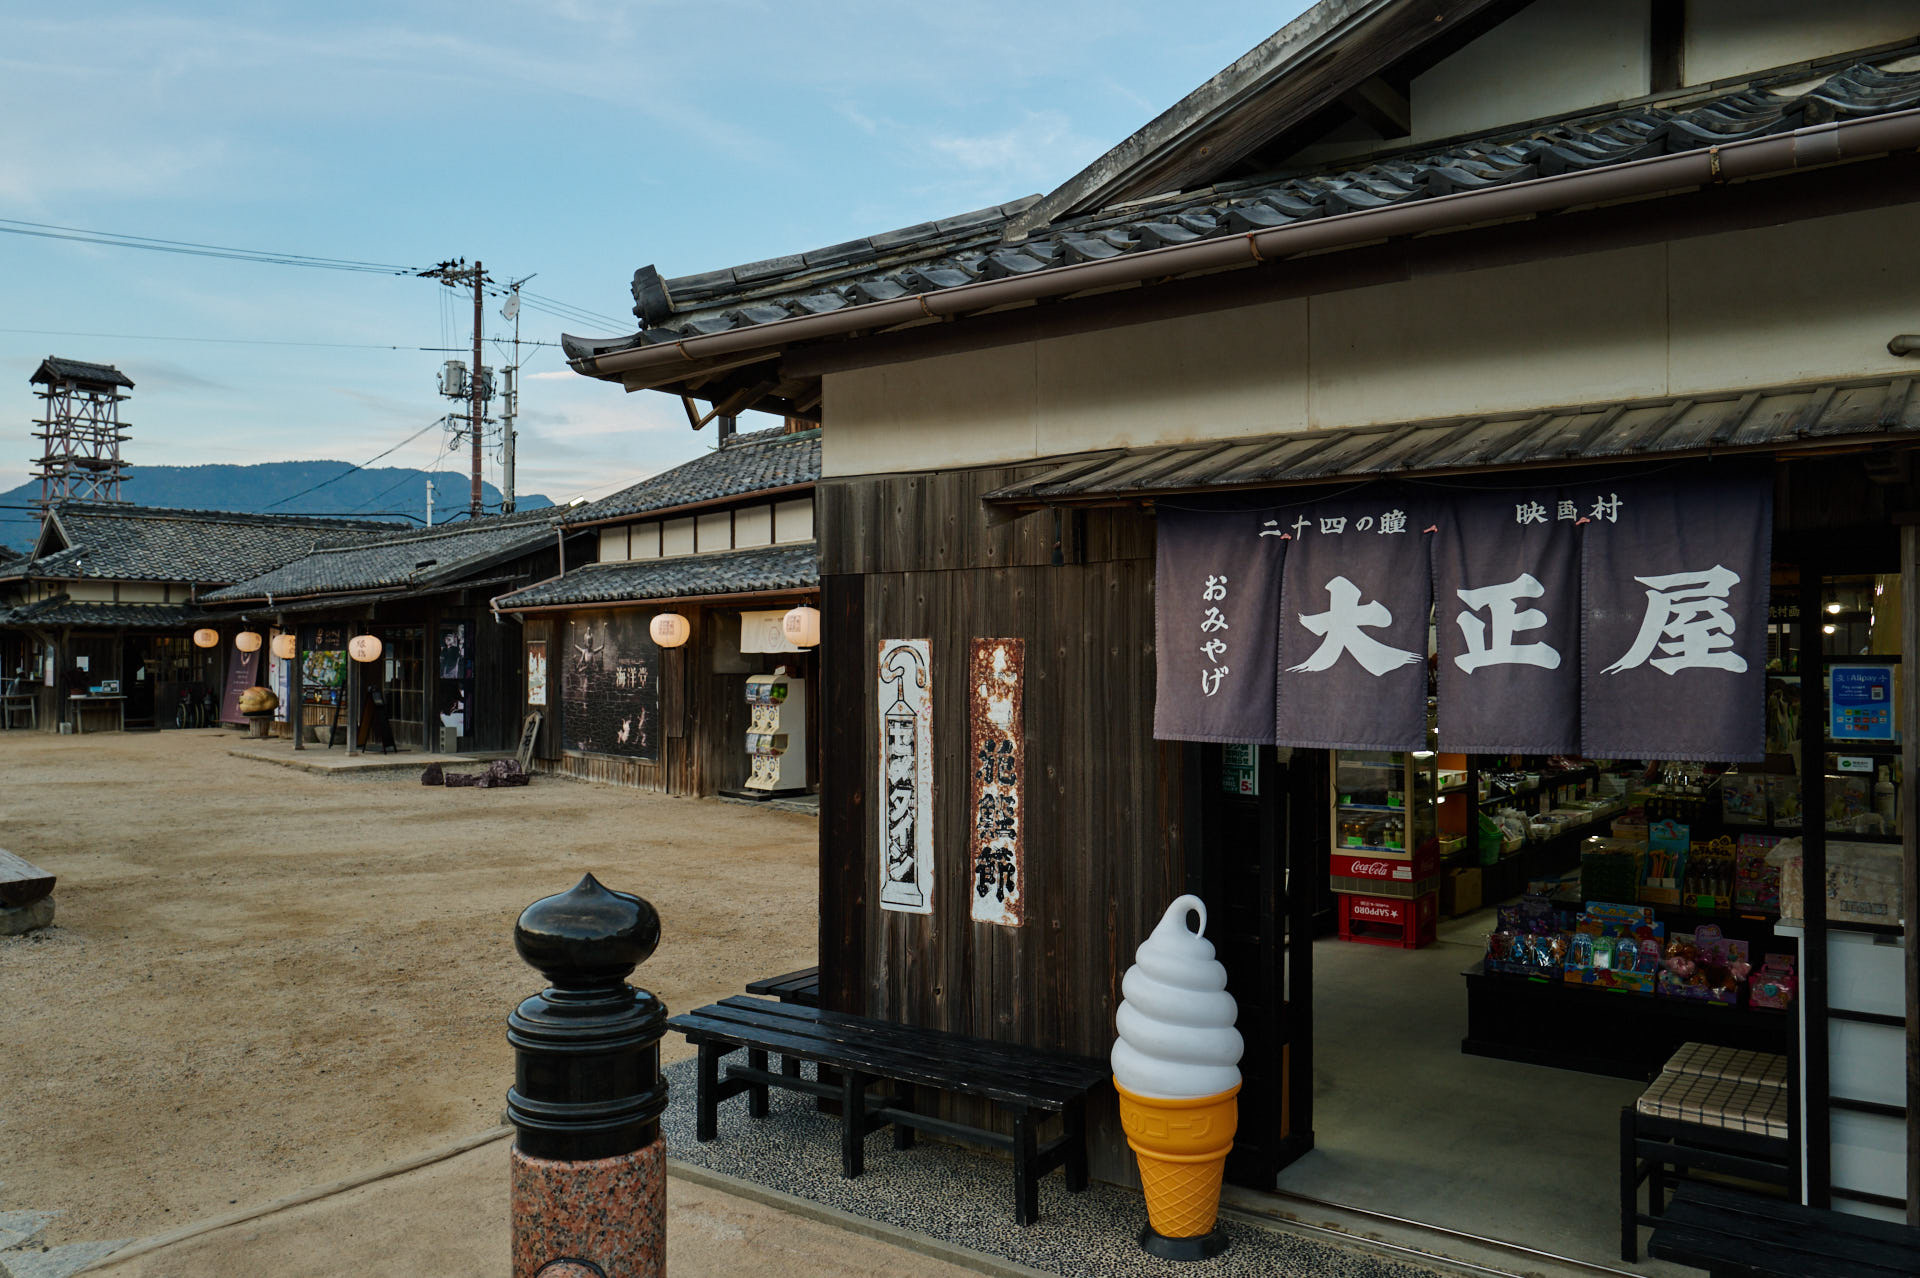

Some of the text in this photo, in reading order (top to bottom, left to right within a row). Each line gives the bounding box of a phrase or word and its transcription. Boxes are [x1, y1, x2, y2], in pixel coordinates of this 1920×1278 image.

[1259, 492, 1623, 541] 二十四の瞳 映画村
[1200, 574, 1230, 697] おみやげ
[1283, 563, 1749, 677] 大正屋
[1354, 905, 1390, 917] SAPPORO
